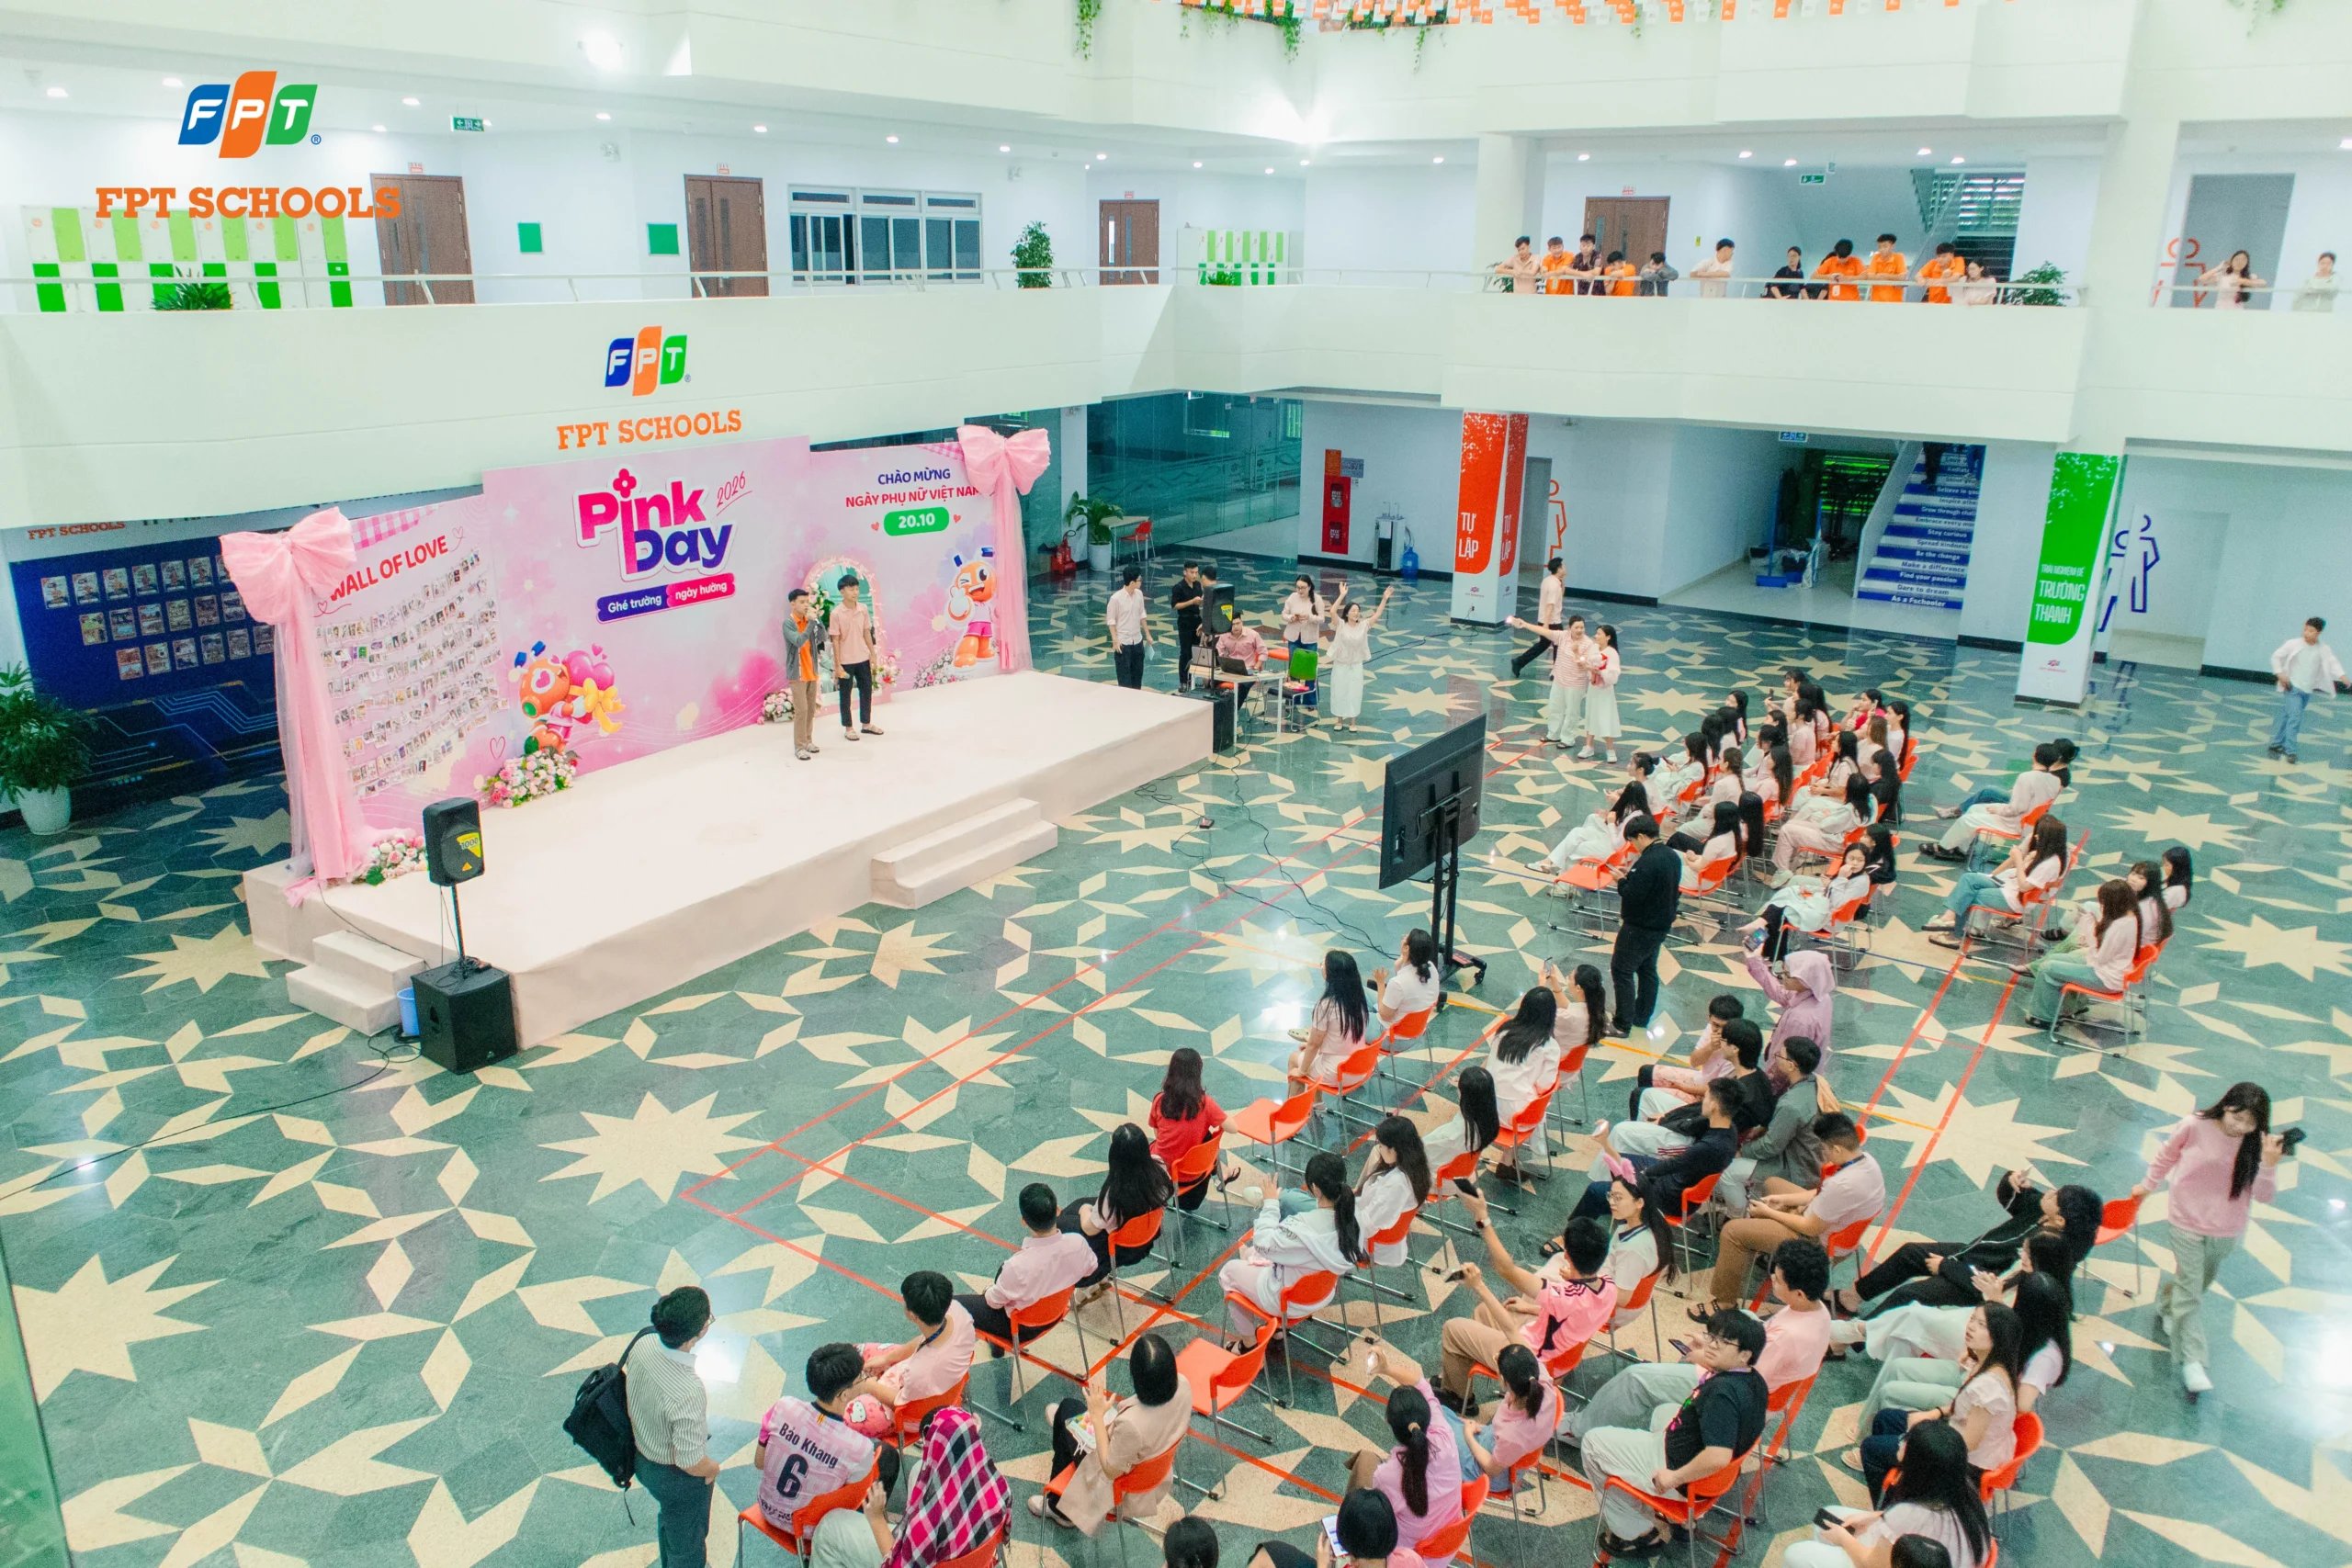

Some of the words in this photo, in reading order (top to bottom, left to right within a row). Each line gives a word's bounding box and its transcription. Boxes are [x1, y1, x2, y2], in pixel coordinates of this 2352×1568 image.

[557, 422, 609, 450] FPT
[617, 410, 742, 445] SCHOOLS
[878, 469, 911, 485] CHÀO
[914, 467, 951, 482] MỪNG
[578, 468, 707, 544] Pink
[717, 470, 746, 508] 2026
[846, 491, 879, 507] NGÀY
[882, 493, 906, 506] PHỤ
[909, 487, 927, 502] NỮ
[929, 485, 954, 502] VIỆT
[898, 513, 935, 529] 20.10
[1938, 507, 1961, 515] through
[27, 527, 56, 540] FPT
[59, 521, 126, 536] SCHOOLS
[1461, 512, 1477, 534] TỰ
[625, 525, 733, 575] Day
[1458, 536, 1479, 560] LẬP
[1940, 541, 1969, 549] kindness
[330, 567, 379, 602] WALL
[379, 554, 402, 579] OF
[404, 535, 448, 569] LOVE
[1928, 562, 1965, 572] difference
[607, 598, 628, 614] Ghé
[629, 594, 662, 609] trường
[675, 586, 698, 601] ngày
[1909, 597, 1947, 607] Fschooler
[1926, 587, 1950, 595] dream
[2039, 580, 2086, 602] TRƯỞNG
[2035, 603, 2073, 625] THÀNH
[779, 1422, 800, 1446] Bảo
[801, 1438, 839, 1469] Khang
[776, 1453, 808, 1498] 6
